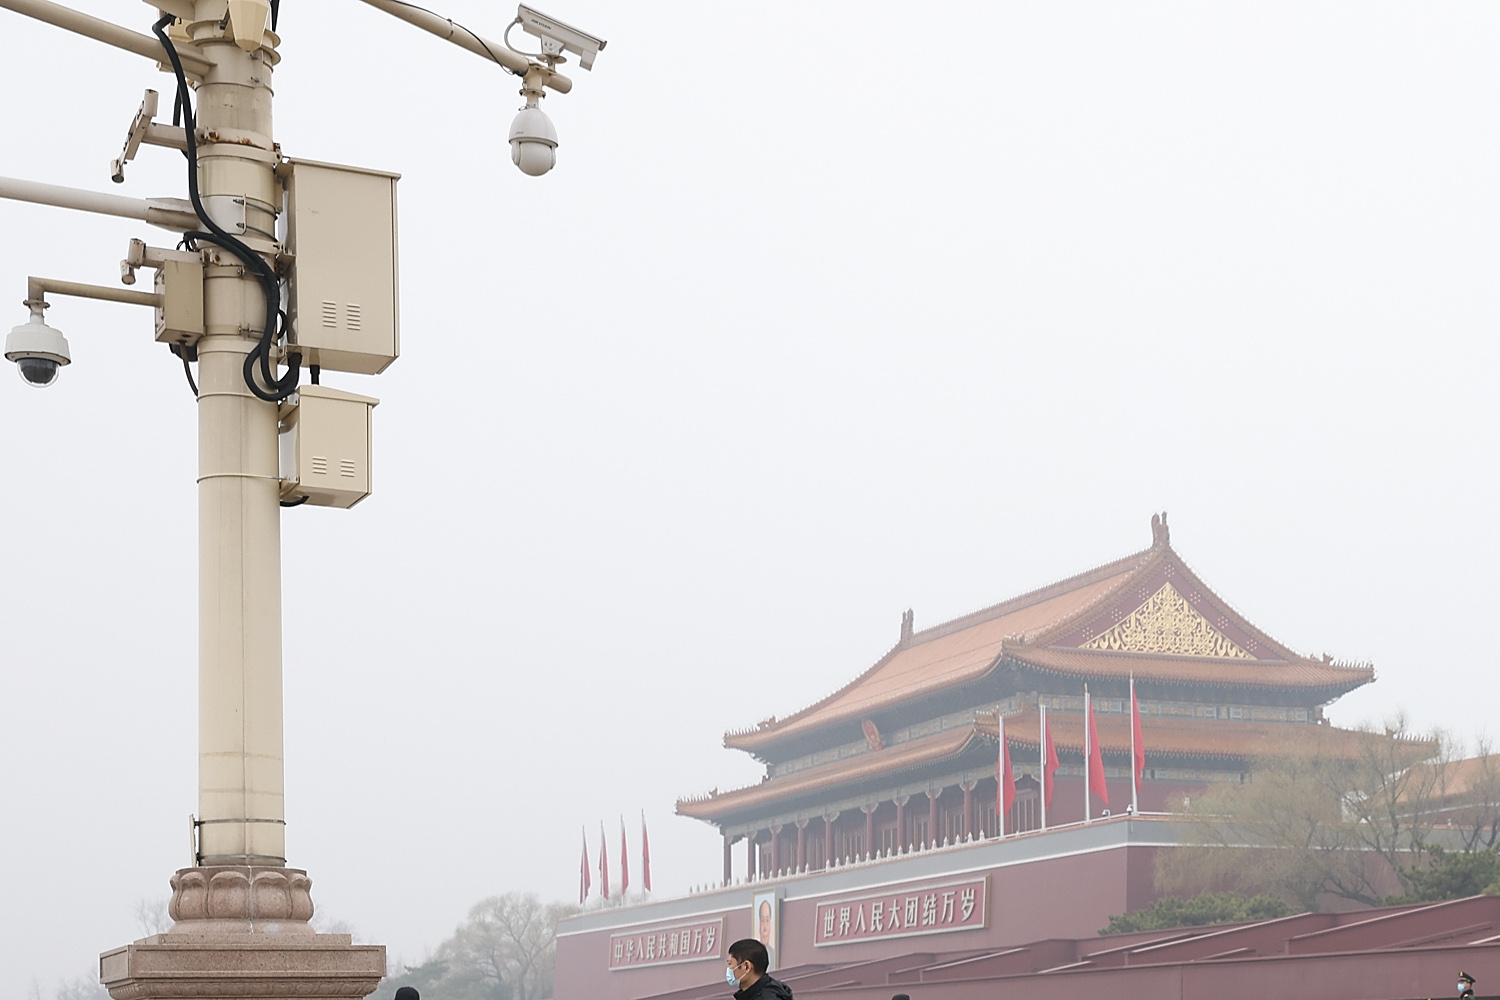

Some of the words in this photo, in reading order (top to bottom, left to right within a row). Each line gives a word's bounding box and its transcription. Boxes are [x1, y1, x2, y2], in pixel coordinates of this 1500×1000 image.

[823, 888, 976, 939] 世界人民大团结万岁
[614, 926, 716, 963] 中华人民共和国万岁
